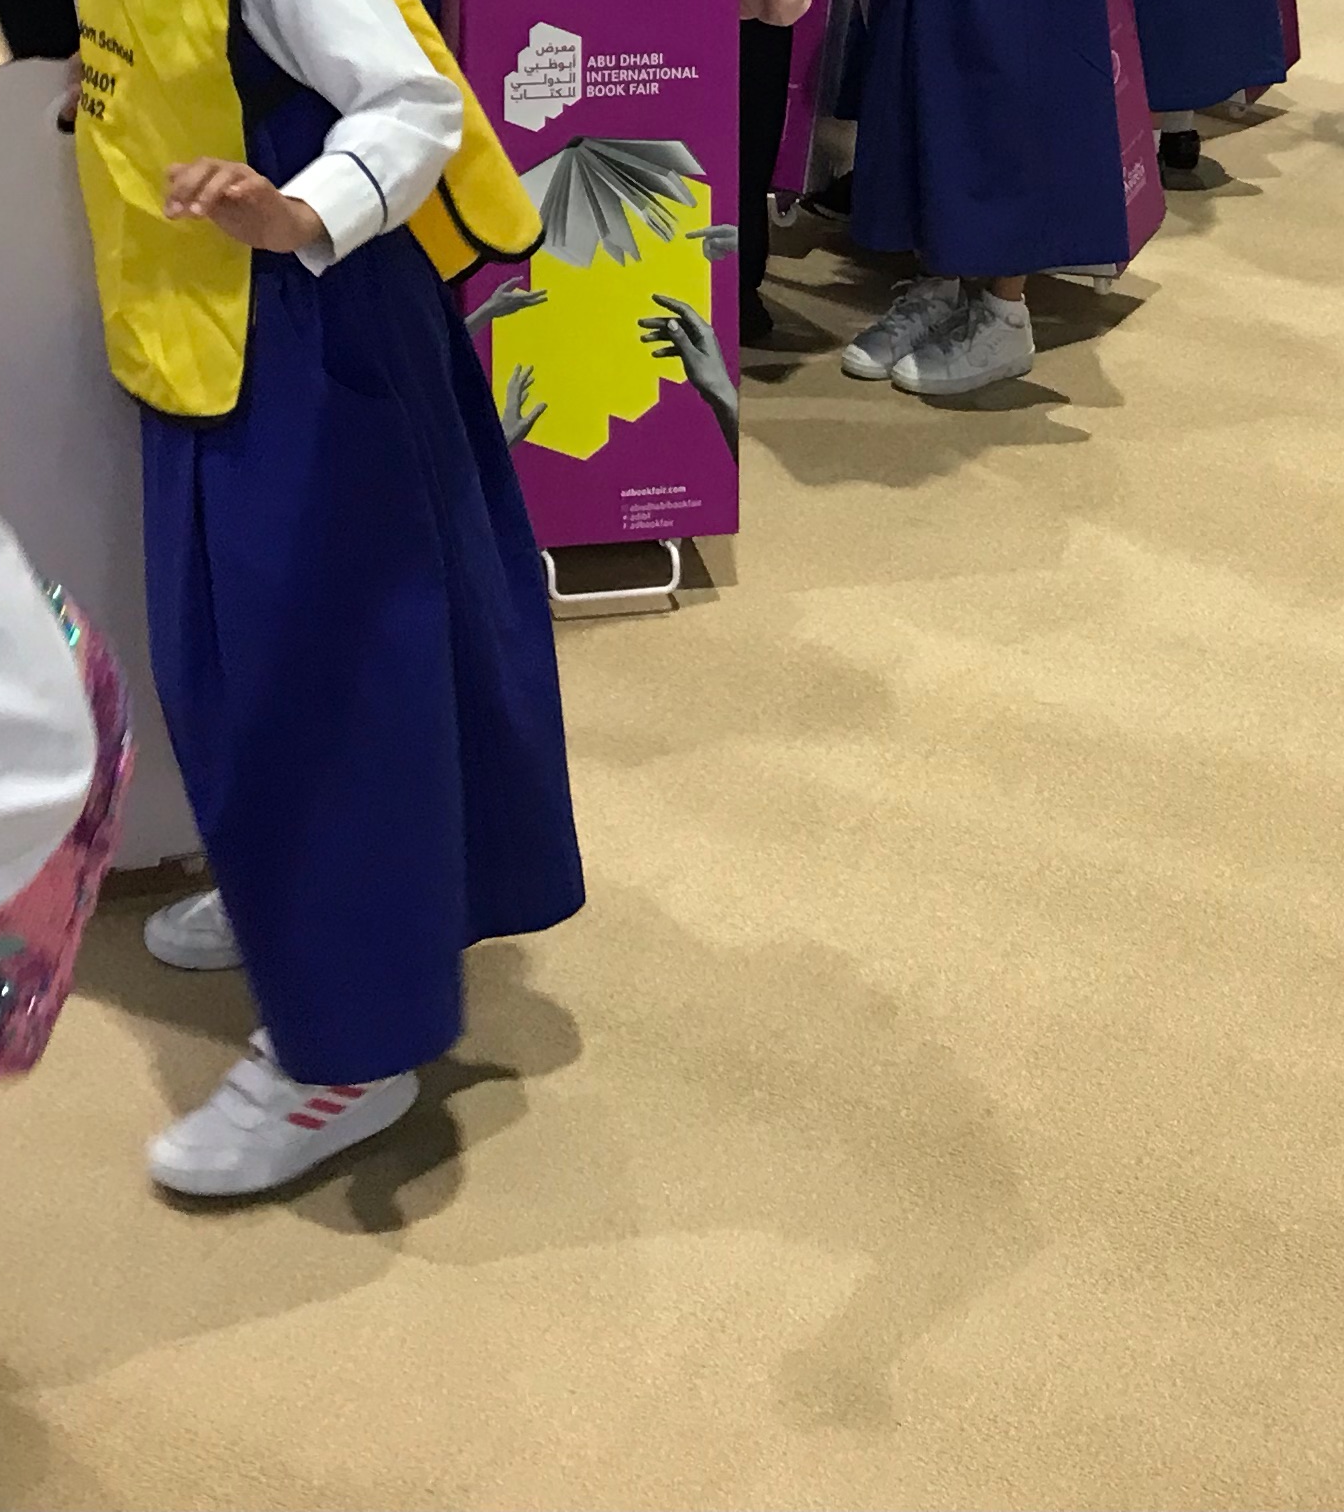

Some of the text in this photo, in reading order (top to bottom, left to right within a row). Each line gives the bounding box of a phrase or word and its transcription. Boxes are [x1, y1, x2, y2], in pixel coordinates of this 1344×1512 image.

[99, 30, 134, 67] School
[536, 42, 576, 57] معرض
[524, 53, 577, 76] أبوظبي
[587, 53, 664, 68] ABU DHABI
[510, 72, 577, 90] الدولي
[586, 66, 699, 83] INTERNATIONAL
[510, 86, 577, 103] للكتاب
[586, 82, 660, 98] BOOK FAIR
